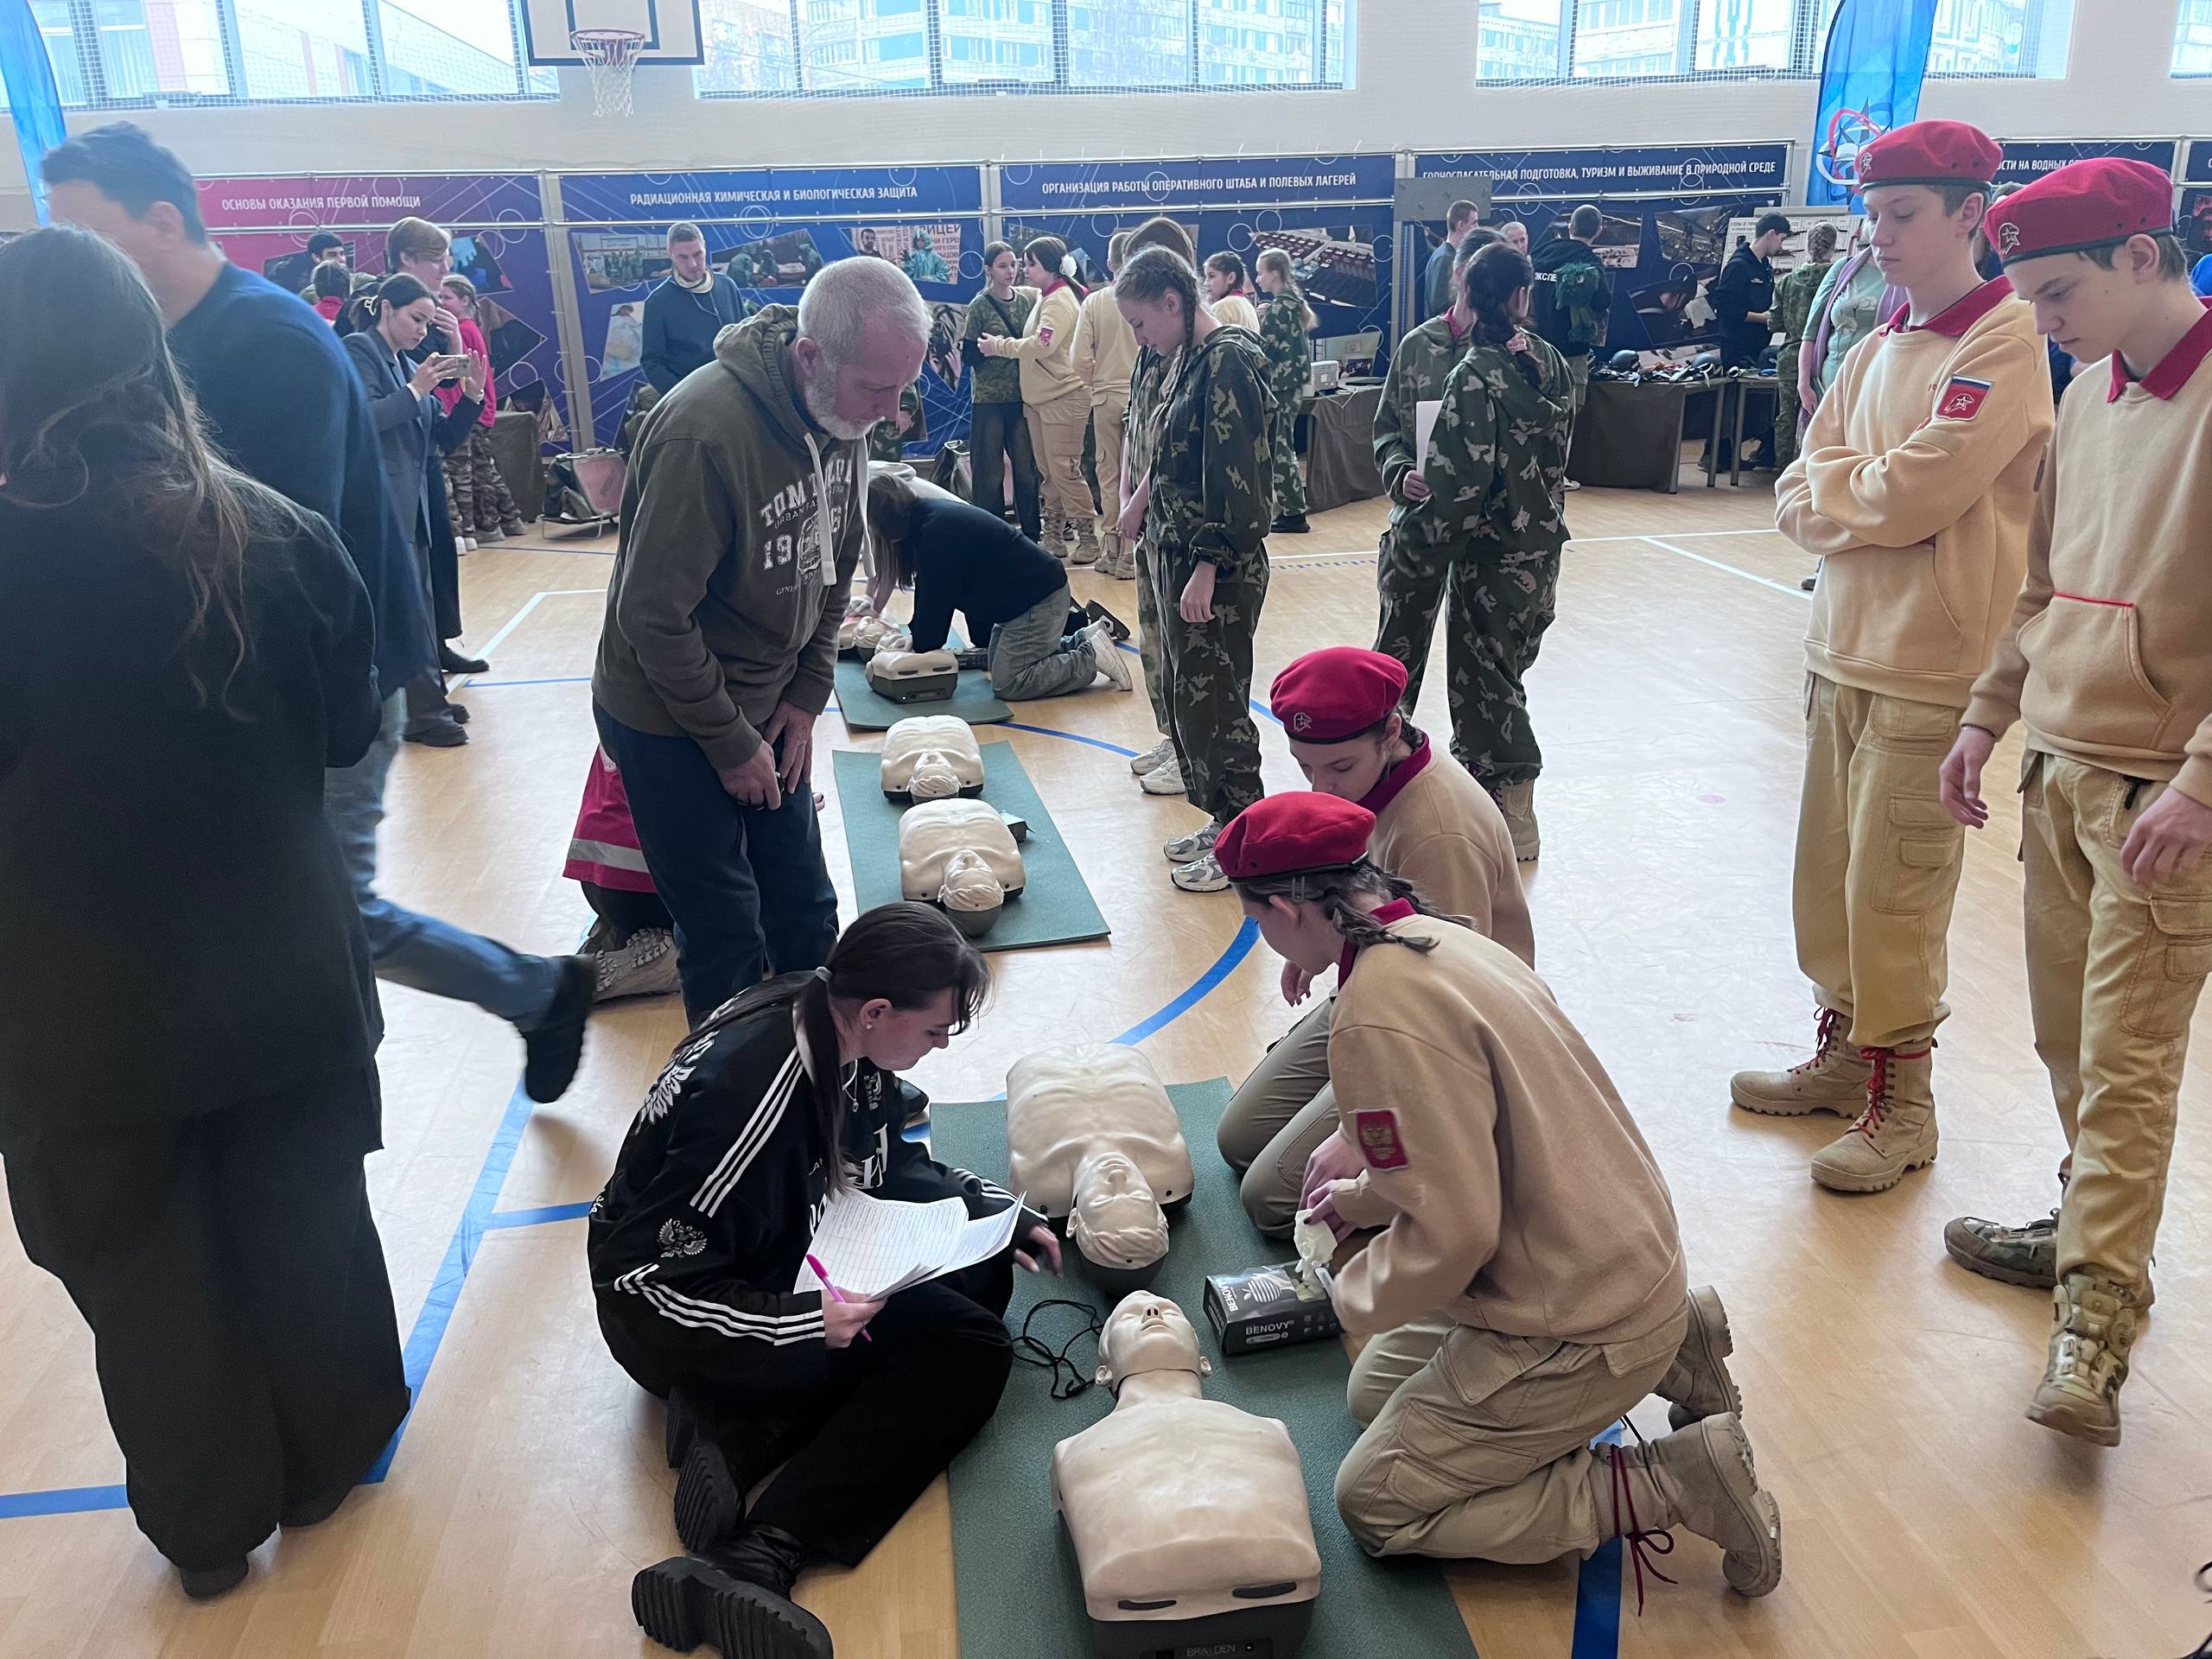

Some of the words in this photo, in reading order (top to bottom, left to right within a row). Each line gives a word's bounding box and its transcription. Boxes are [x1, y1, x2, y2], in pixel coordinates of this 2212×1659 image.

[1520, 168, 1579, 181] ПОДГОТОВКА,
[1581, 167, 1616, 177] ТУРИЗМ
[1618, 166, 1625, 177] И
[1627, 164, 1683, 177] ВЫЖИВАНИЕ
[1686, 164, 1692, 175] В
[1694, 161, 1746, 175] ПРИРОДНОЙ
[1749, 162, 1776, 174] СРЕДЕ
[2018, 160, 2030, 170] НА
[2031, 159, 2066, 171] ВОДНЫХ
[1042, 181, 1109, 194] ОРГАНИЗАЦИЯ
[1112, 181, 1149, 193] РАБОТЫ
[1152, 178, 1223, 191] ОПЕРАТИВНОГО
[1225, 177, 1257, 189] ШТАБА
[1260, 177, 1266, 188] И
[1268, 175, 1313, 188] ПОЛЕВЫХ
[1315, 173, 1357, 187] ЛАГЕРЕЙ
[221, 198, 266, 211] ОСНОВЫ
[269, 197, 324, 209] ОКАЗАНИЯ
[327, 194, 369, 208] ПЕРВОЙ
[372, 195, 421, 208] ПОМОЩИ
[630, 193, 711, 207] РАДИАЦИОННАЯ
[714, 190, 780, 202] ХИМИЧЕСКАЯ
[783, 189, 791, 200] И
[793, 188, 874, 200] БИОЛОГИЧЕСКАЯ
[878, 187, 918, 200] ЗАЩИТА
[1535, 272, 1558, 282] ЭКСПЕ
[760, 480, 806, 528] TOM
